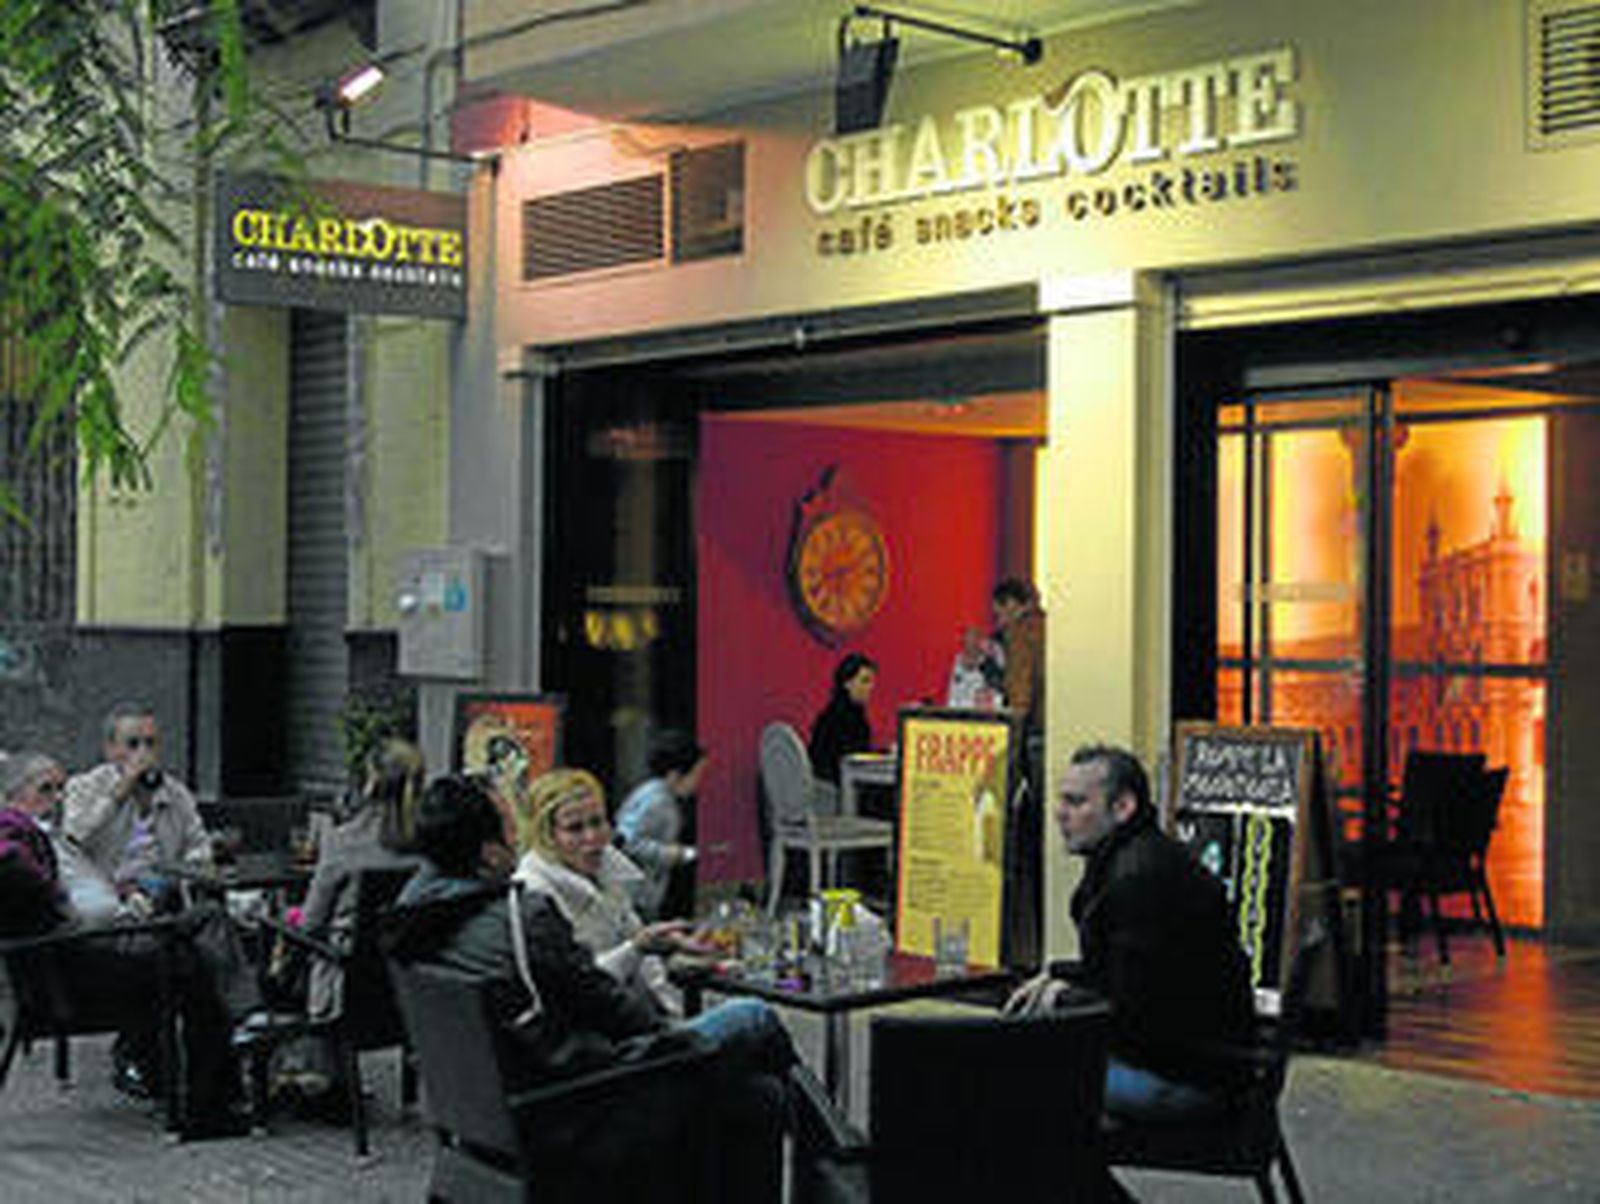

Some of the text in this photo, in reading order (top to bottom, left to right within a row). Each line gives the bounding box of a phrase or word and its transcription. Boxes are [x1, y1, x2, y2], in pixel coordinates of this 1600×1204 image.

[805, 47, 1300, 215] CHARLOTTE
[231, 208, 463, 267] CHARLOTTE
[817, 155, 1299, 256] café snacks cocktails
